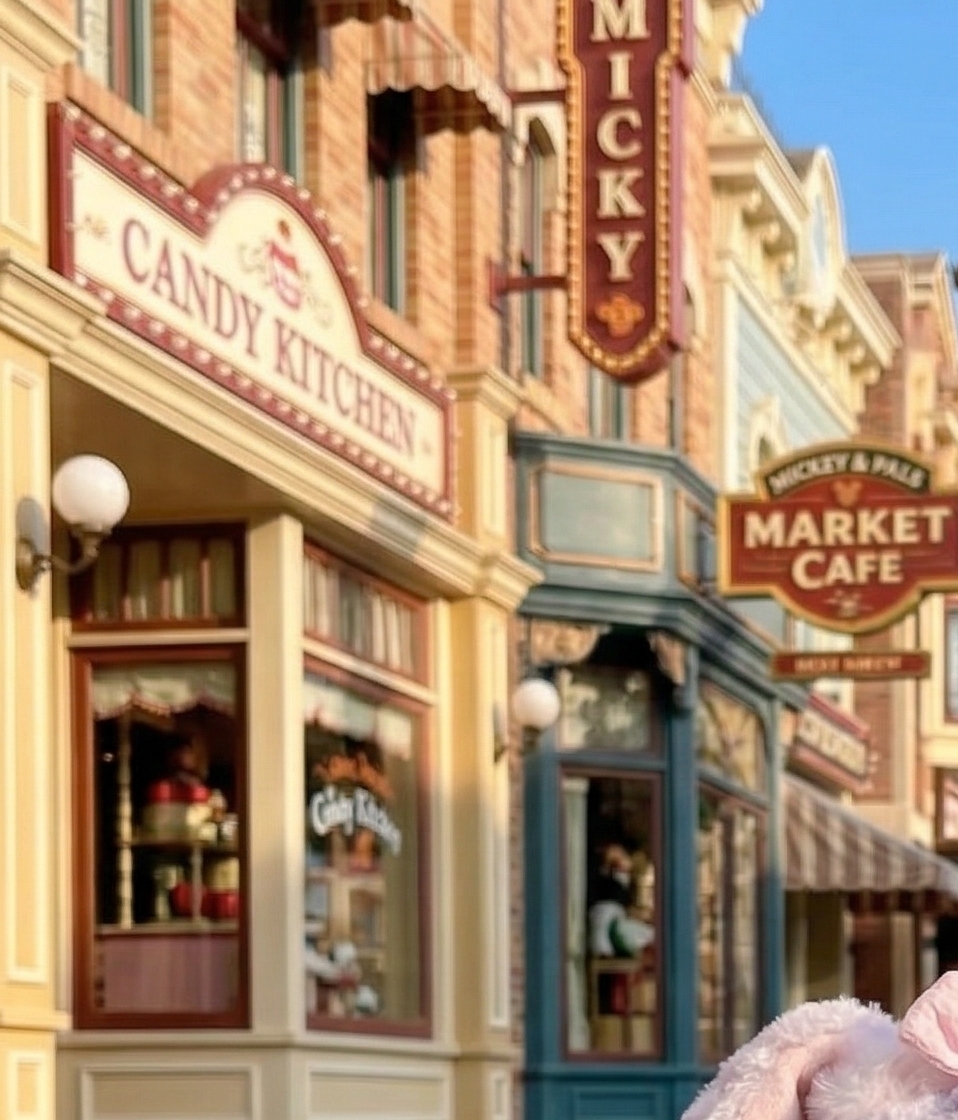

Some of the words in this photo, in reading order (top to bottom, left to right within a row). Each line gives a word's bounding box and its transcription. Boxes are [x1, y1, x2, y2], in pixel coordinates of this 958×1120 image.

[589, 0, 651, 282] MICKY
[122, 219, 264, 358] CANDY
[273, 321, 417, 458] KITCHEN
[852, 451, 870, 472] &
[744, 506, 953, 548] MARKET
[792, 551, 903, 589] CAFE
